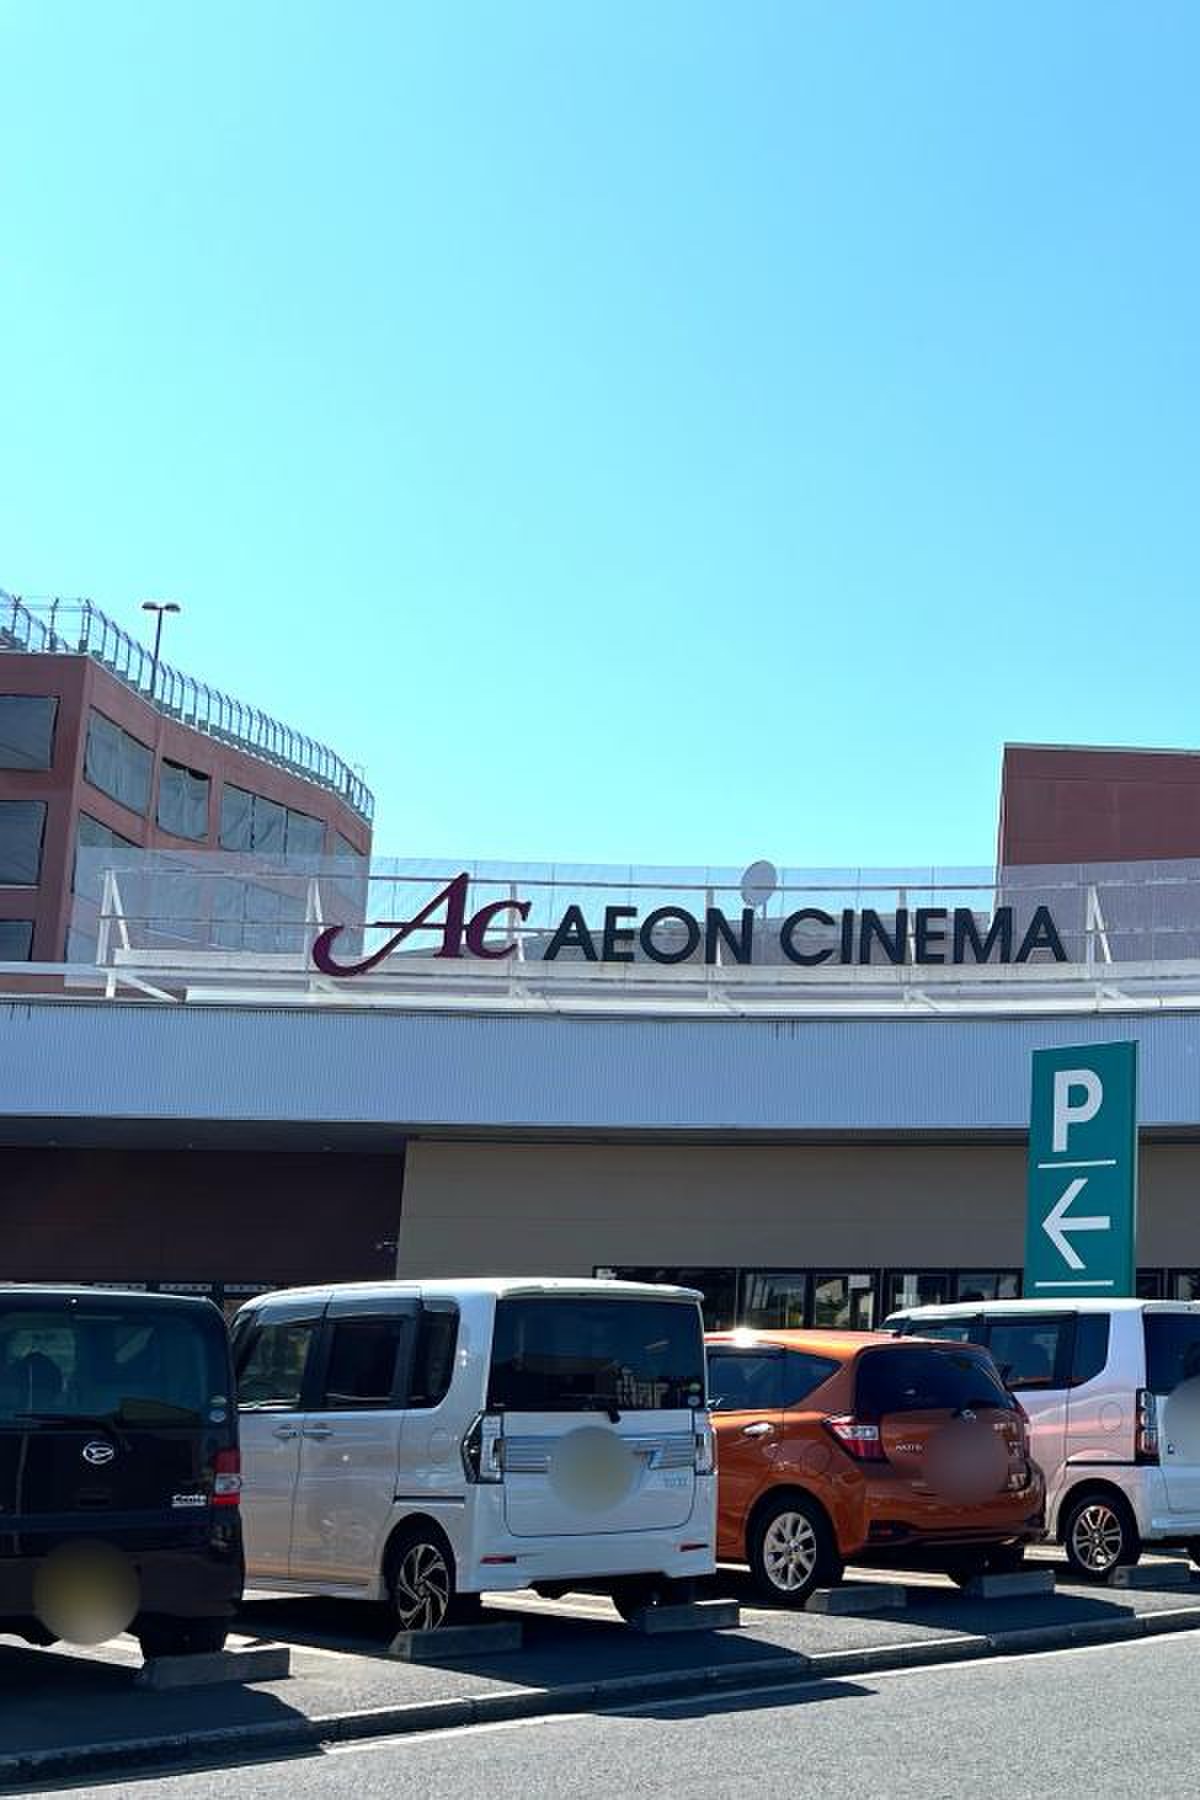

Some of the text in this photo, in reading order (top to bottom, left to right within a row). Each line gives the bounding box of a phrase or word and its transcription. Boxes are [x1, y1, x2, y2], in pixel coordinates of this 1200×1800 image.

[543, 904, 755, 965] AEON
[779, 905, 1069, 966] CINEMA
[1052, 1069, 1103, 1152] P
